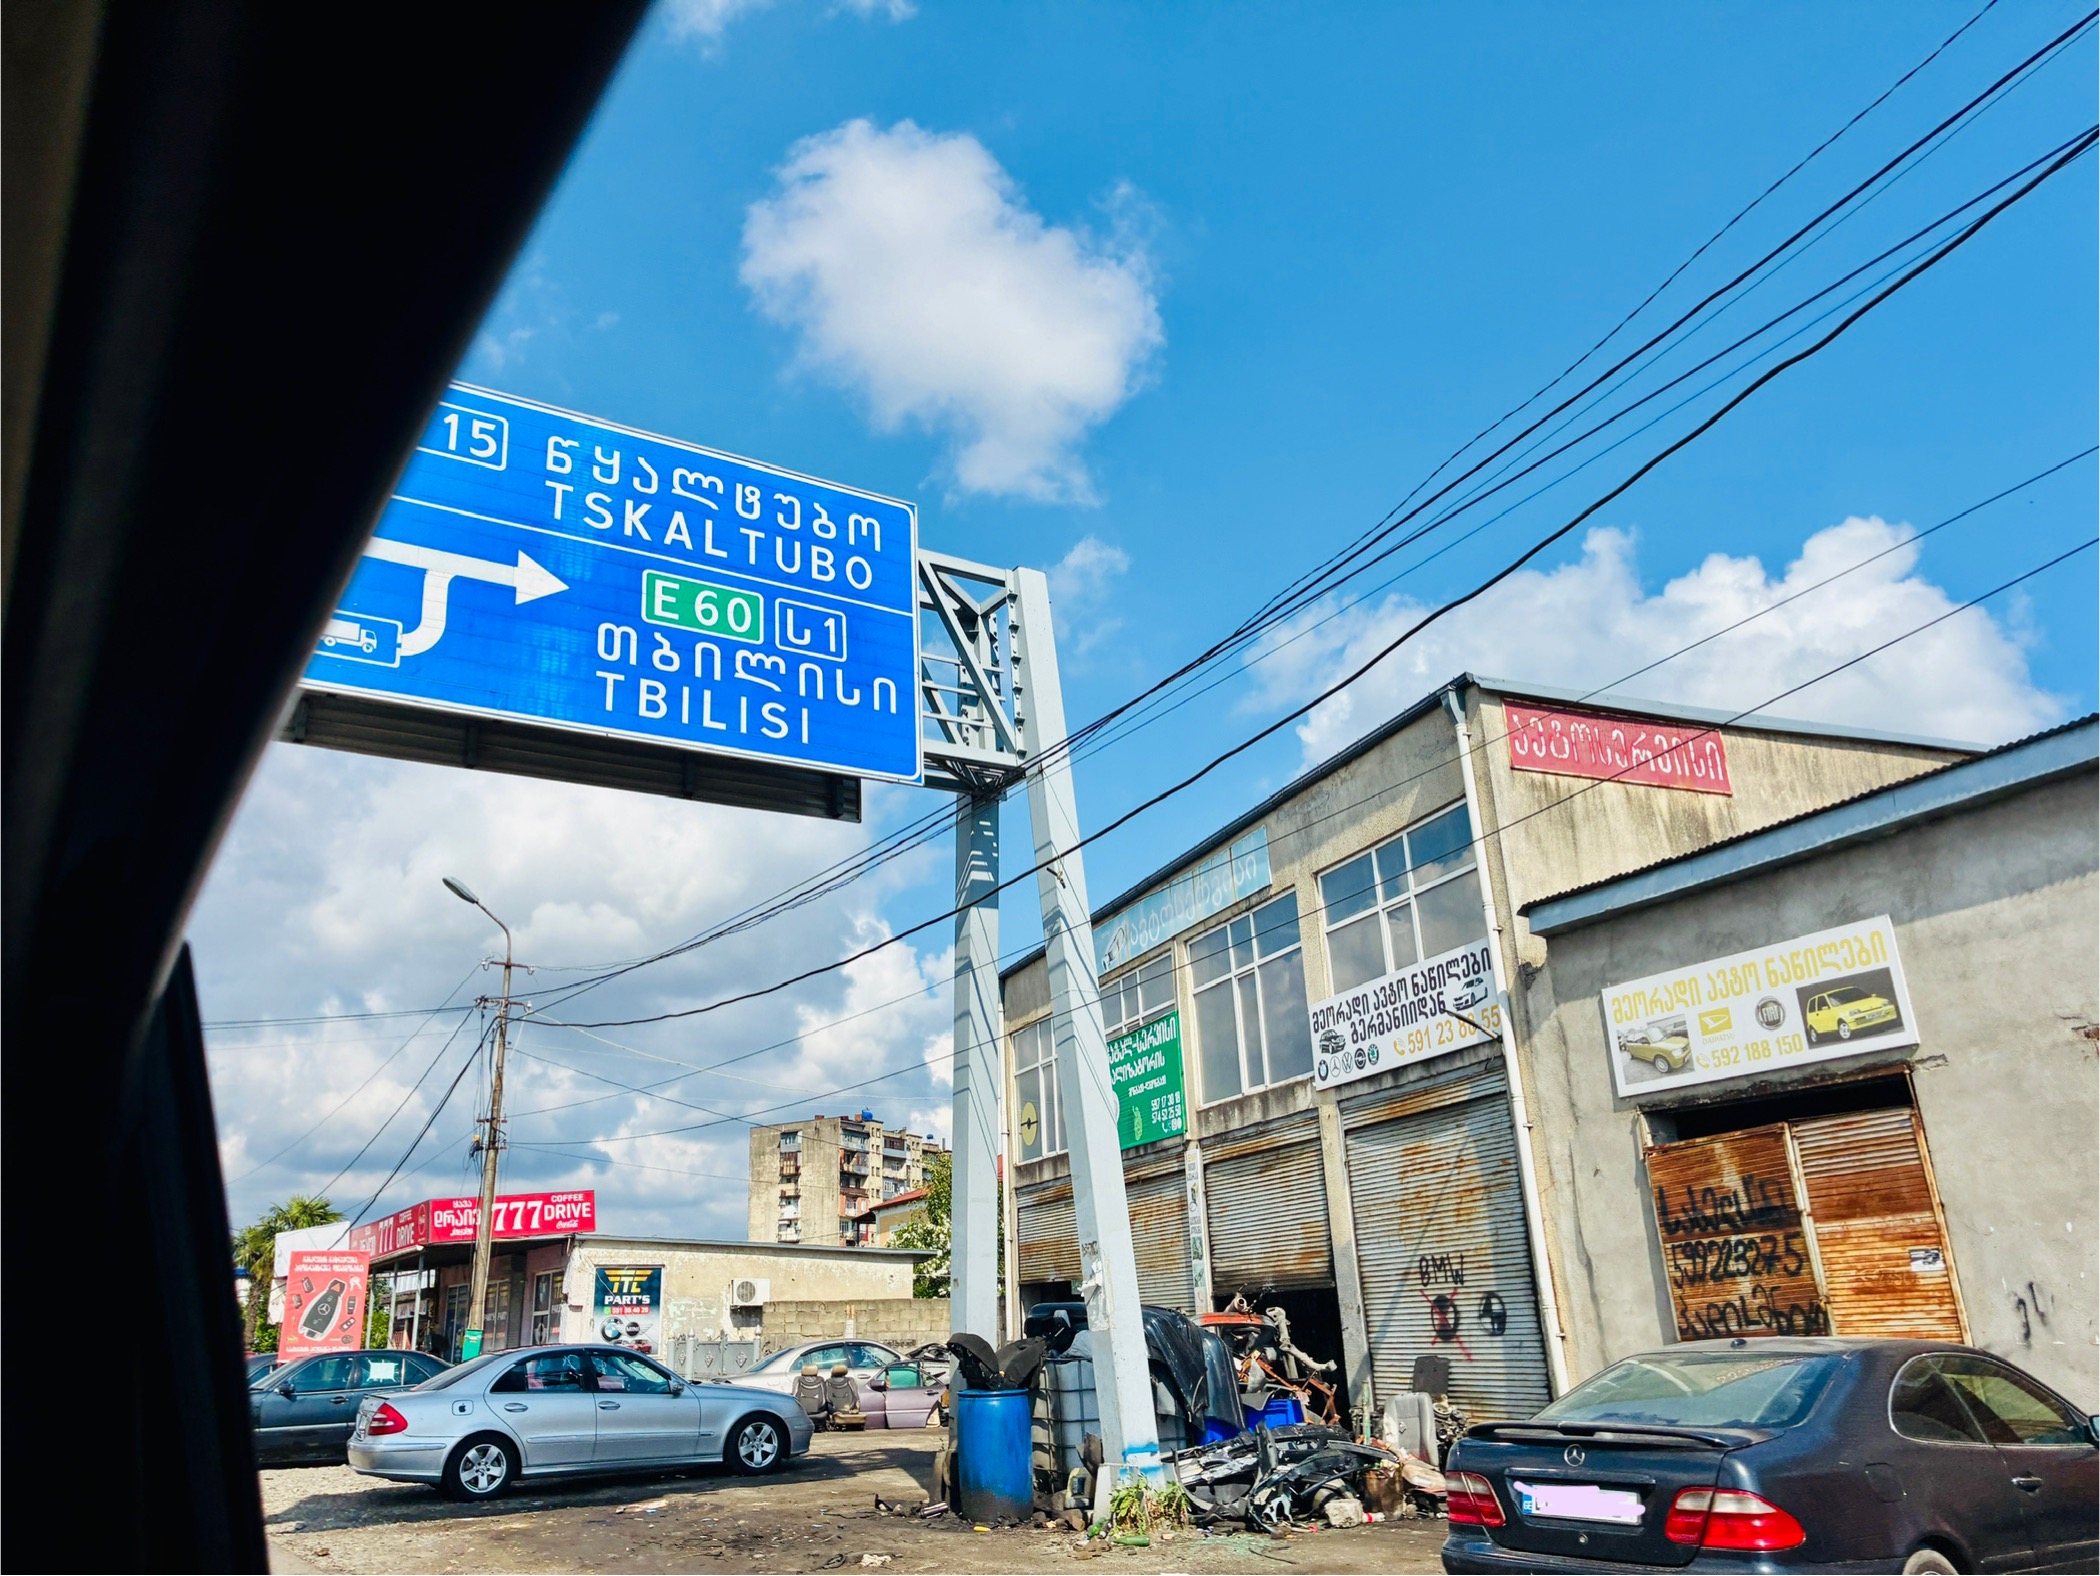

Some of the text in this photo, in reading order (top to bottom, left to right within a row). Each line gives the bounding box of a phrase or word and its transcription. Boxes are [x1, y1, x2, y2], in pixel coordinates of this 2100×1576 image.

[443, 413, 497, 458] 15
[546, 435, 881, 552] წყალტუბო
[545, 480, 873, 590] TSKALTUBO
[654, 579, 752, 633] E 60
[597, 622, 897, 714] თბილისი
[596, 670, 809, 744] TBILISI
[1512, 714, 1724, 780] ავტოსერვისი
[1130, 855, 1256, 947] ავტოსერვისი
[1312, 946, 1492, 1034] მეორადი ავტო ნაწილები
[1612, 930, 1887, 1025] მეორადი ავტო ნაწილები
[1350, 991, 1447, 1044] გერმანიიდან
[1407, 1024, 1431, 1055] 591
[1436, 1019, 1454, 1046] 23
[1481, 1005, 1501, 1030] 55
[1711, 1033, 1804, 1069] 592 188 150
[492, 1200, 543, 1232] 777
[544, 1202, 592, 1221] DRIVE
[551, 1193, 584, 1203] COFFEE
[396, 1222, 415, 1249] DRIVE
[1419, 1254, 1465, 1287] BMW
[604, 1295, 651, 1305] PART'S
